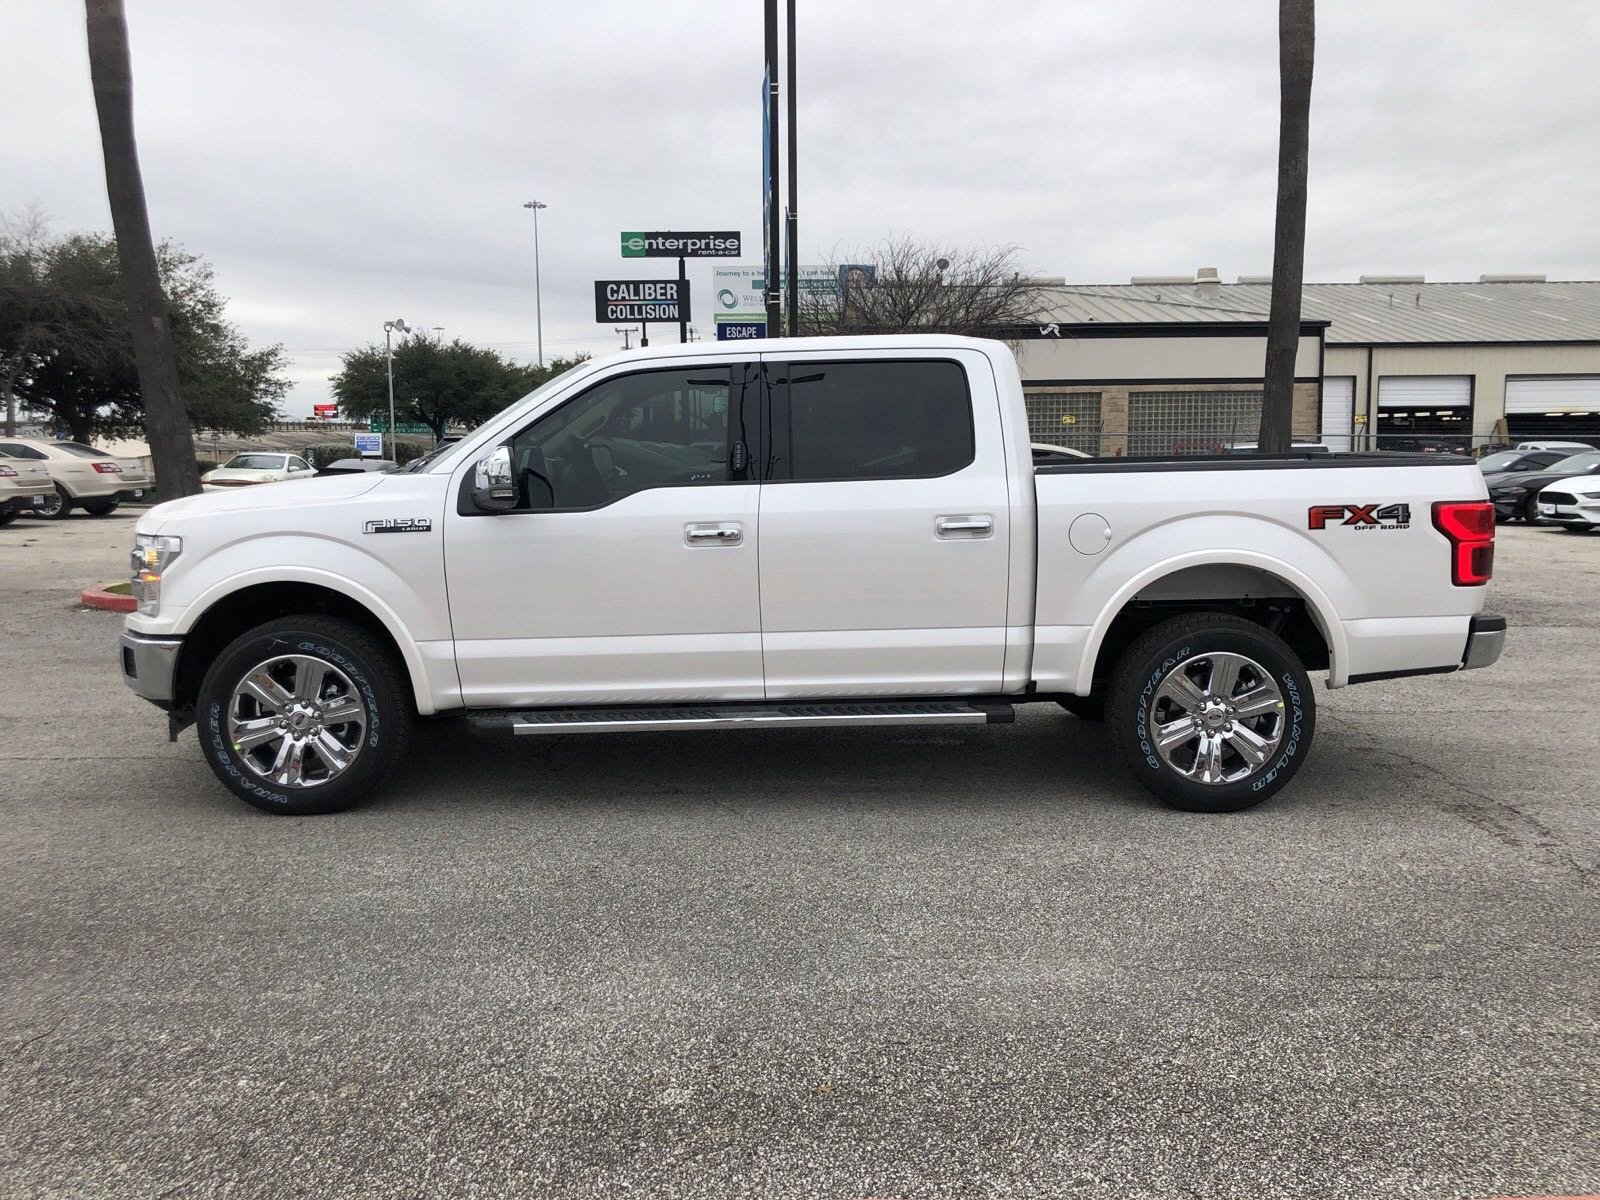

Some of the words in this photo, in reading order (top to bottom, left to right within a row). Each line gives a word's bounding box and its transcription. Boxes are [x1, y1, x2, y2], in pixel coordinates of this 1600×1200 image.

[627, 235, 739, 252] enterprise
[607, 283, 678, 301] CALIBER
[607, 303, 679, 319] COLLISION
[726, 326, 757, 338] ESCAPE
[1308, 503, 1411, 530] FX4
[296, 641, 380, 747] GOODYEAR
[1136, 646, 1191, 769] GOODYEAR
[1252, 672, 1304, 792] WRANGLER
[208, 703, 289, 804] WRANGLER
